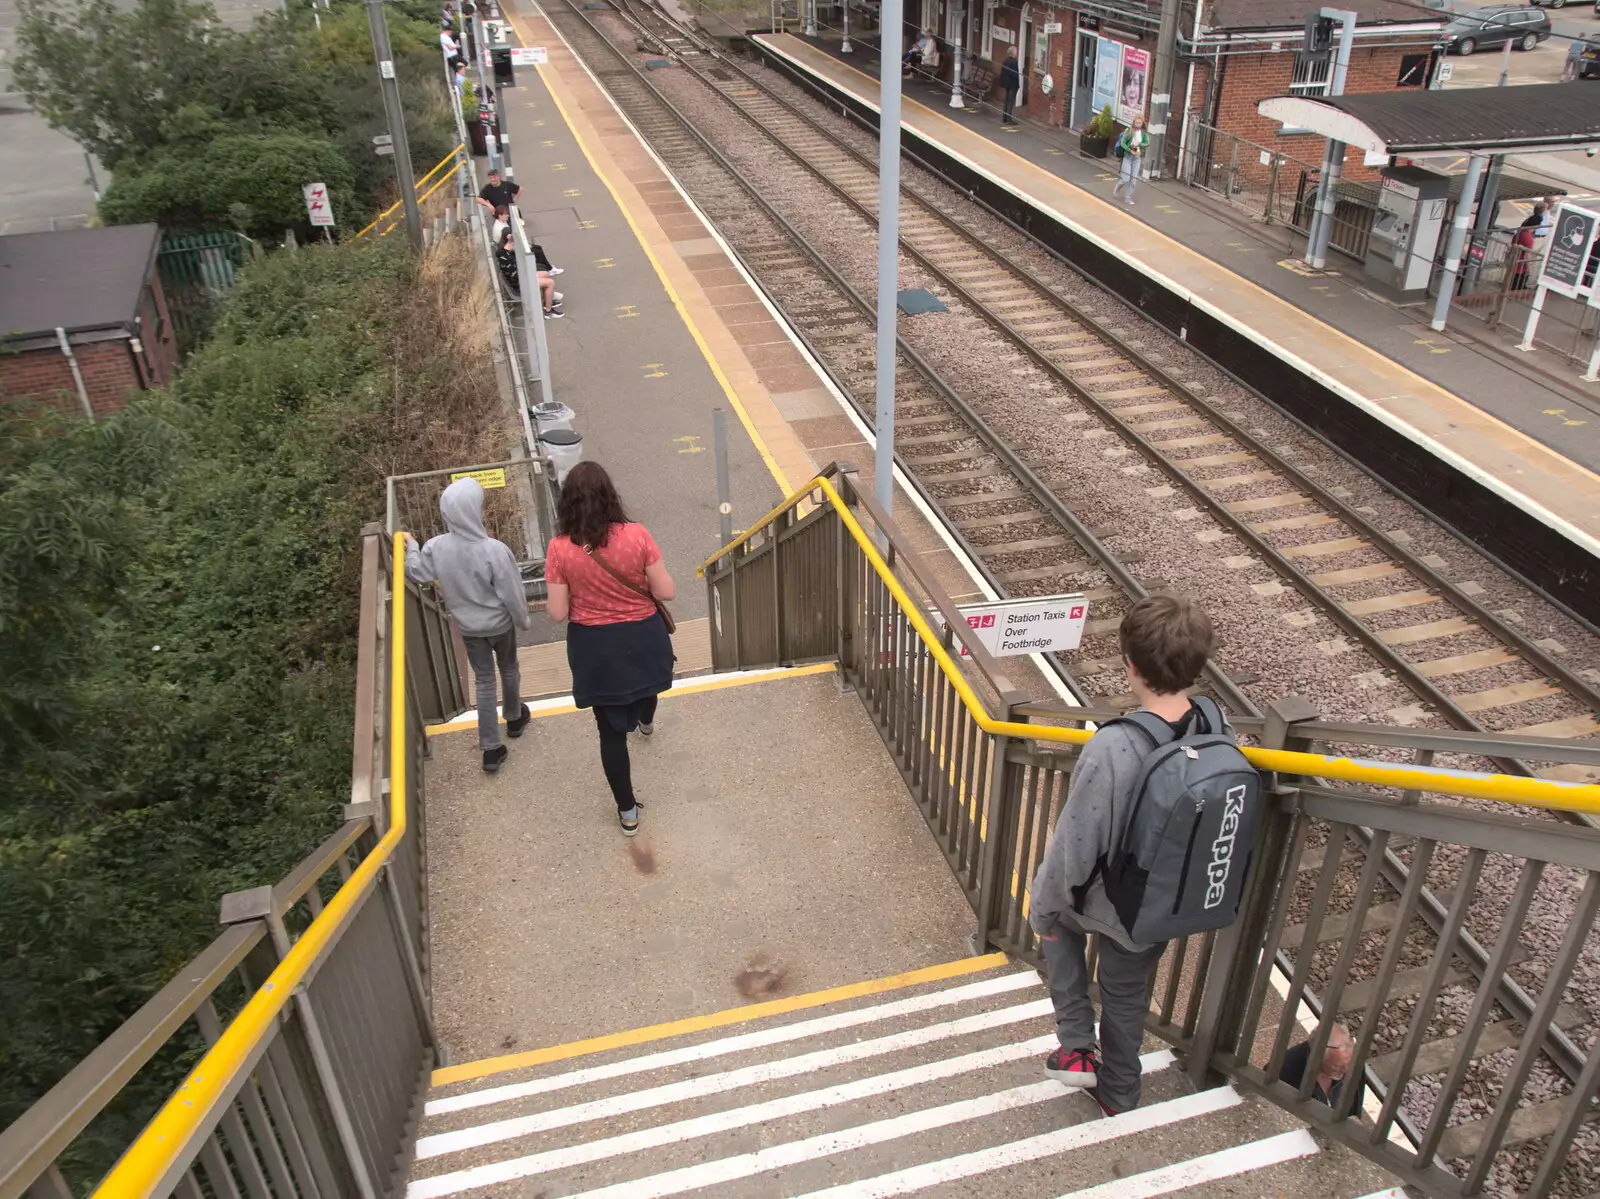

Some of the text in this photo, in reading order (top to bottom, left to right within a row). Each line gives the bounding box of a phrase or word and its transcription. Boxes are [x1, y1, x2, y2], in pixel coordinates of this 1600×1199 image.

[1007, 610, 1066, 624] Station Taxis
[1005, 627, 1027, 637] Over
[1002, 638, 1052, 650] Footbridge
[1204, 784, 1246, 909] Kappa
